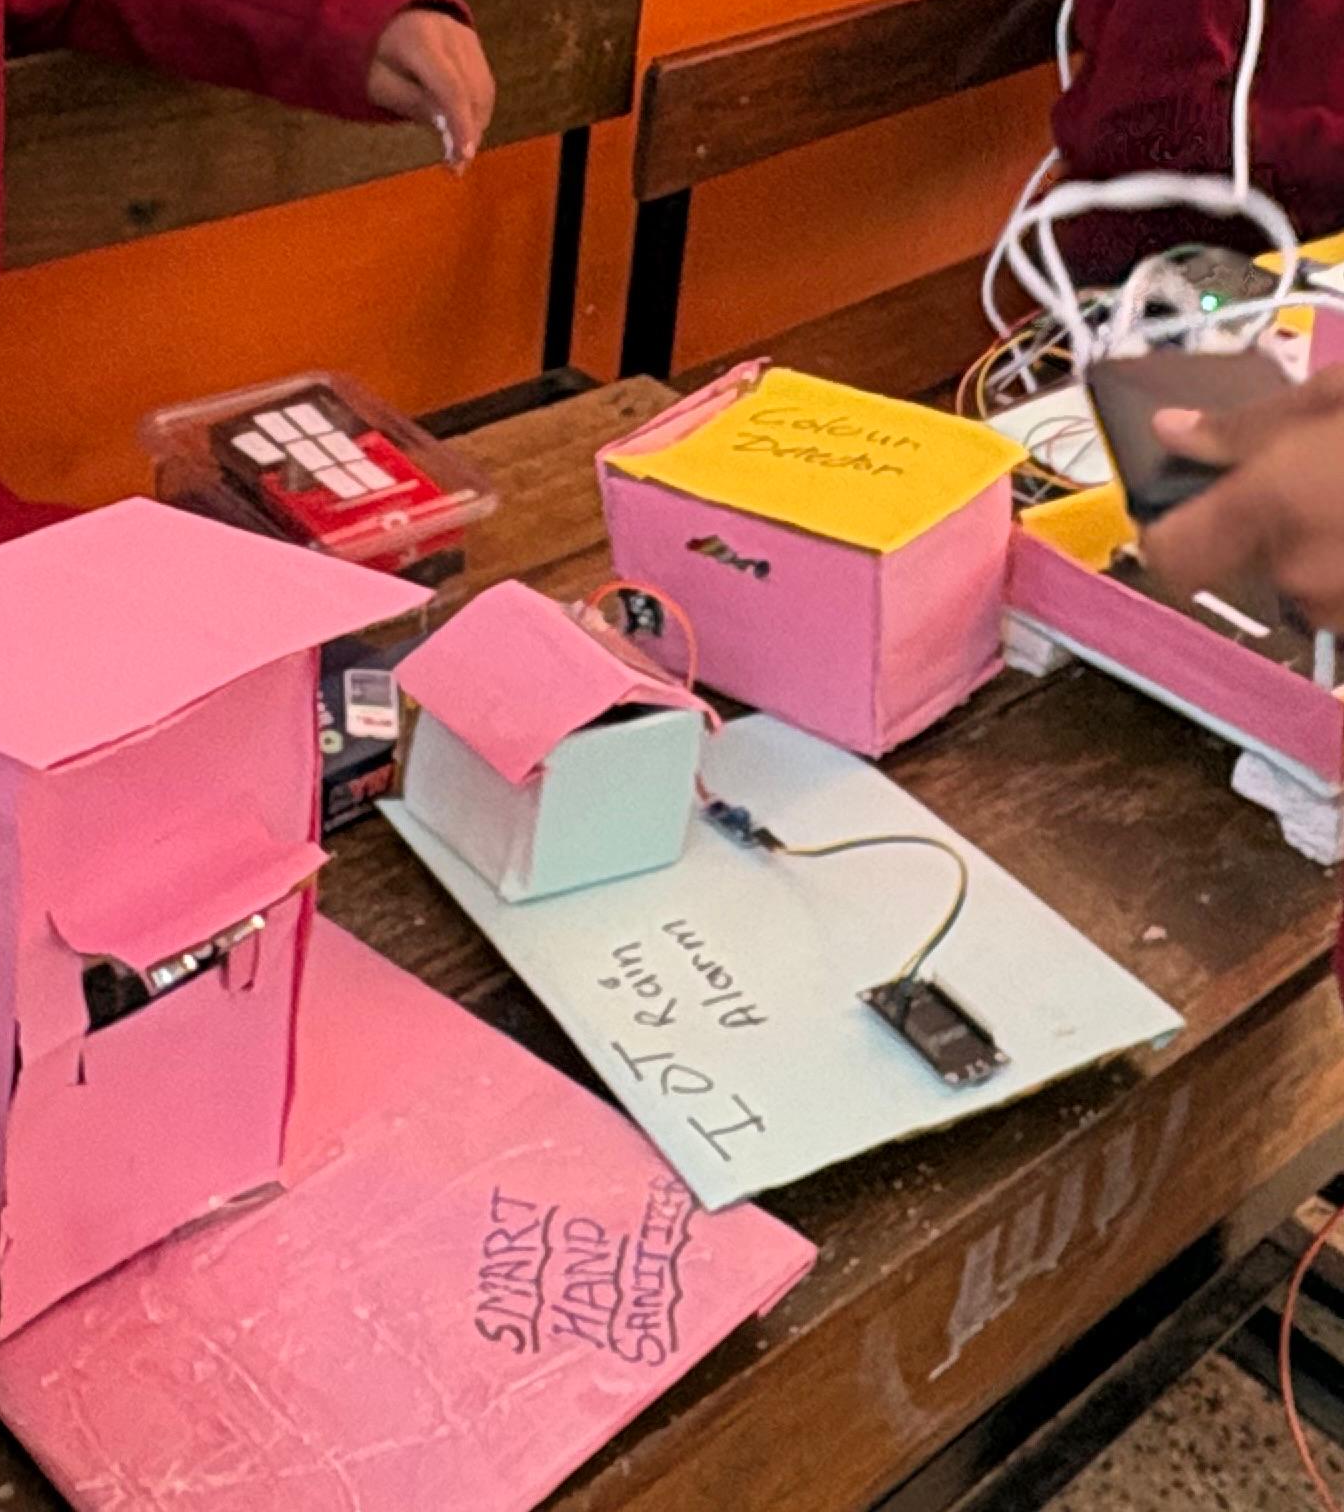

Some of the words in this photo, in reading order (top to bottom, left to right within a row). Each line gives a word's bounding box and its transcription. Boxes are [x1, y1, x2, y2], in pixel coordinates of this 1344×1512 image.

[662, 919, 769, 1027] Alarm
[475, 1186, 540, 1354] SMART
[552, 1217, 611, 1349] HAND
